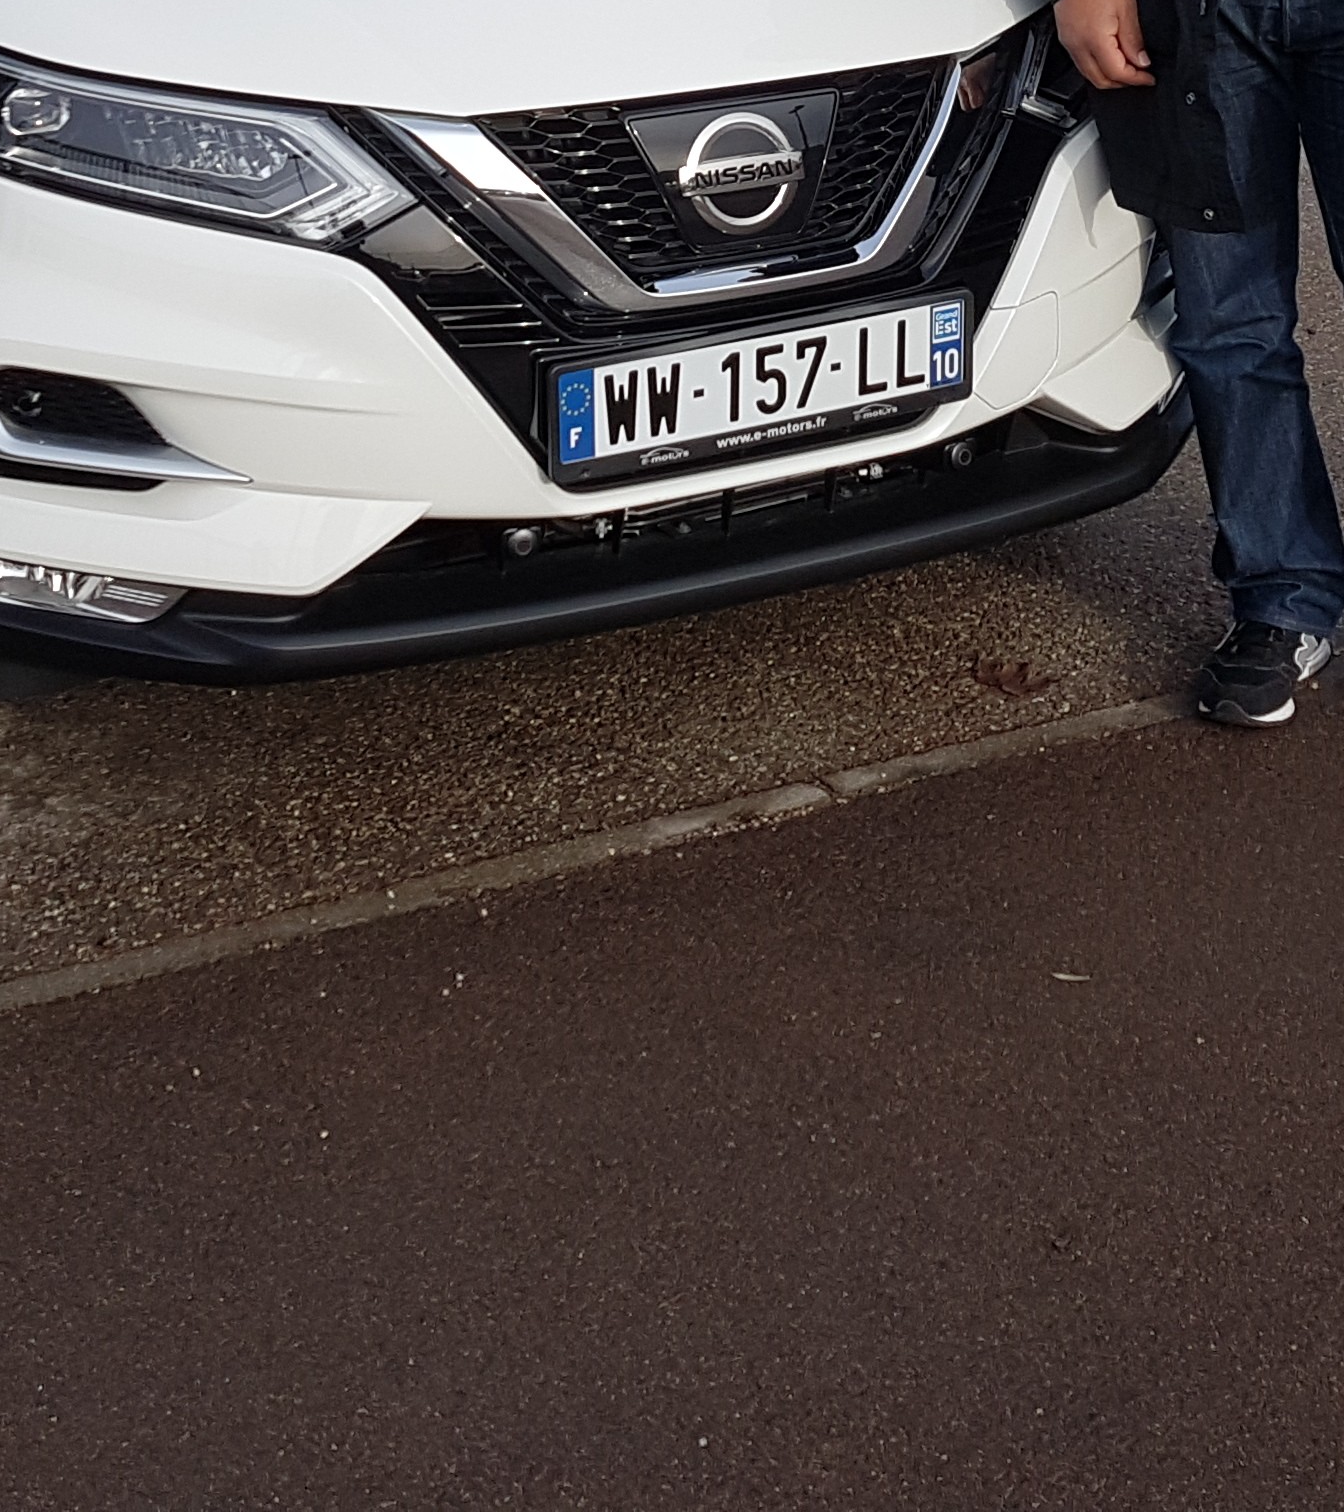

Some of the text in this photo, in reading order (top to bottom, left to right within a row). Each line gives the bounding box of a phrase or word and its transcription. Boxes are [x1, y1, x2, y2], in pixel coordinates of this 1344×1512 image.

[694, 158, 793, 189] NISSAN
[935, 319, 958, 336] Est
[933, 344, 959, 382] 10
[569, 427, 582, 449] F
[716, 416, 827, 449] www.e-motors.fr
